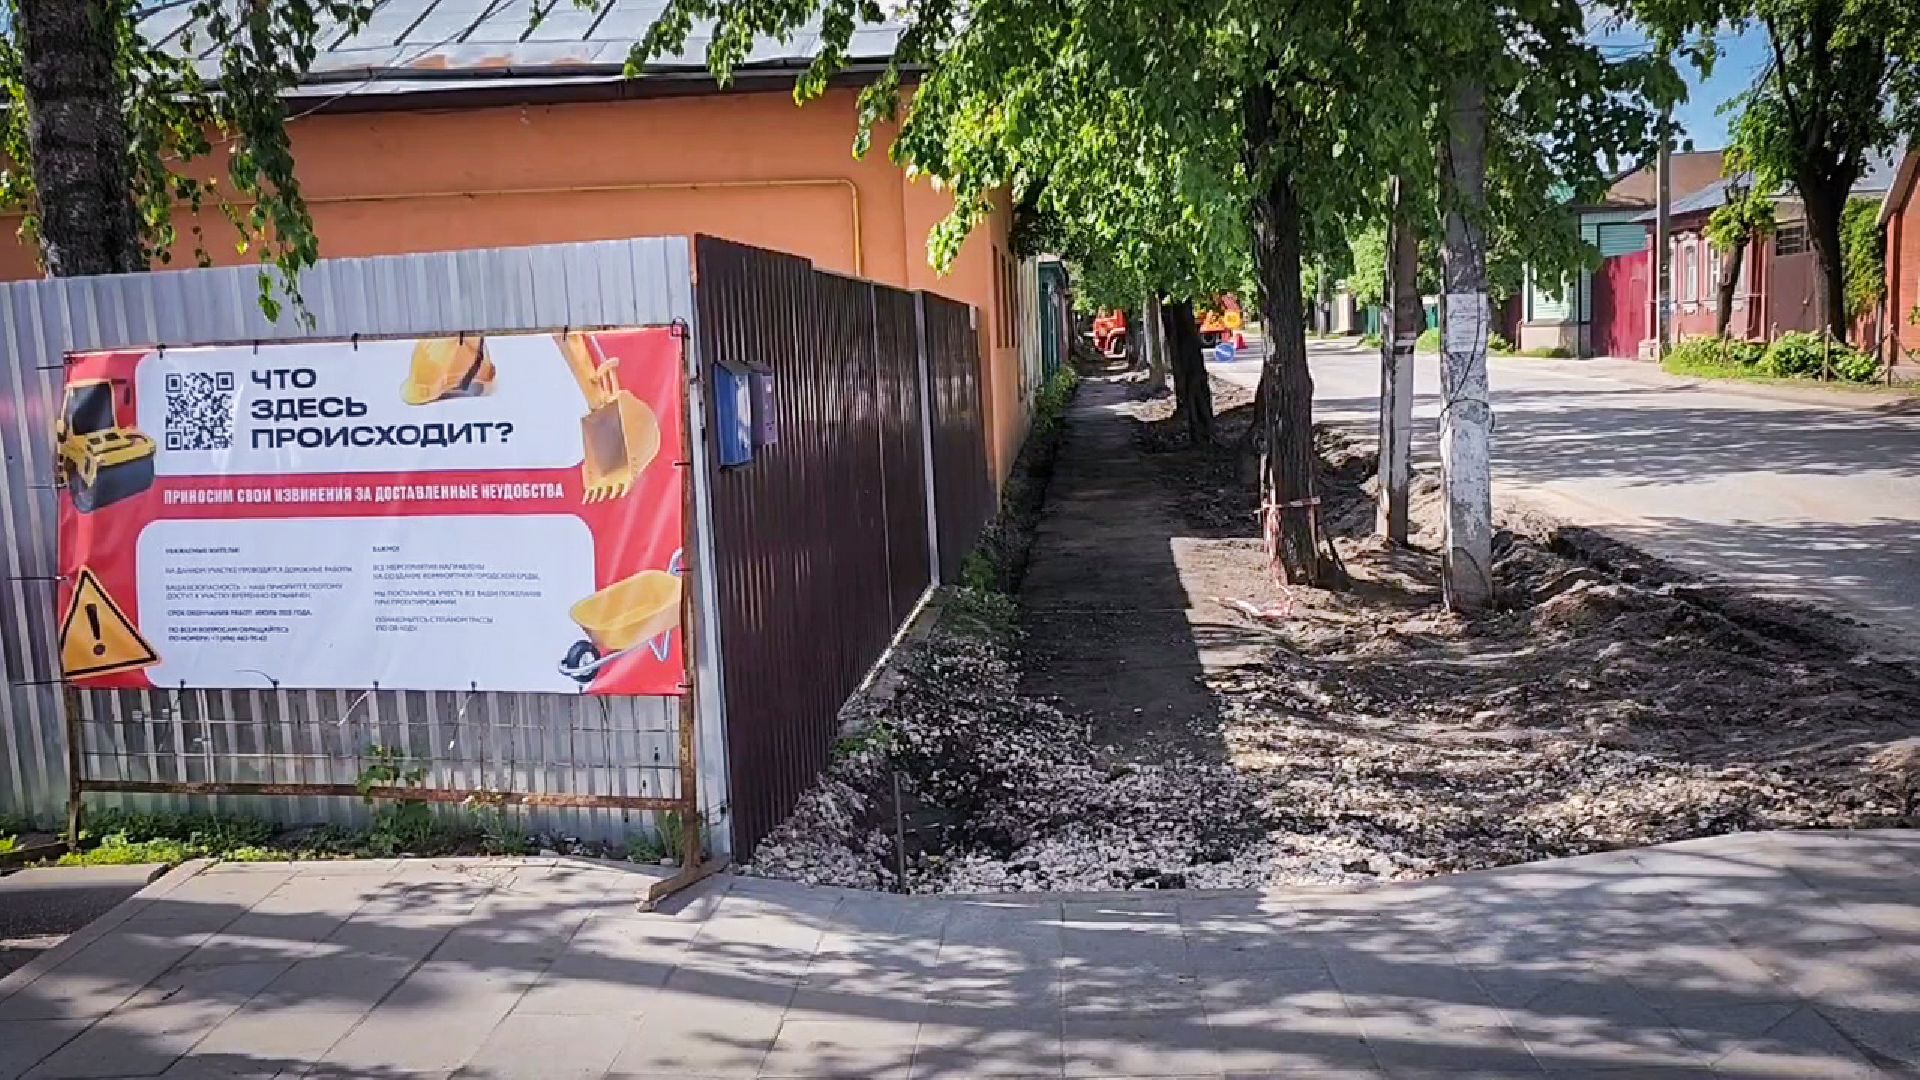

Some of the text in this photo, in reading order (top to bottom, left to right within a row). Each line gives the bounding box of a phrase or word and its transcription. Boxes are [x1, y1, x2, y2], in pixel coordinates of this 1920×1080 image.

[251, 368, 317, 391] ЧТО
[250, 396, 368, 421] ЗДЕСЬ
[251, 421, 515, 449] ПРОИСХОДИТ?
[164, 482, 565, 505] ПРИНОСИМ СВОИ ИЗВИНЕНИЯ ЗА ДОСТАВЛЕННЫЕ НЕУДОБСТВА
